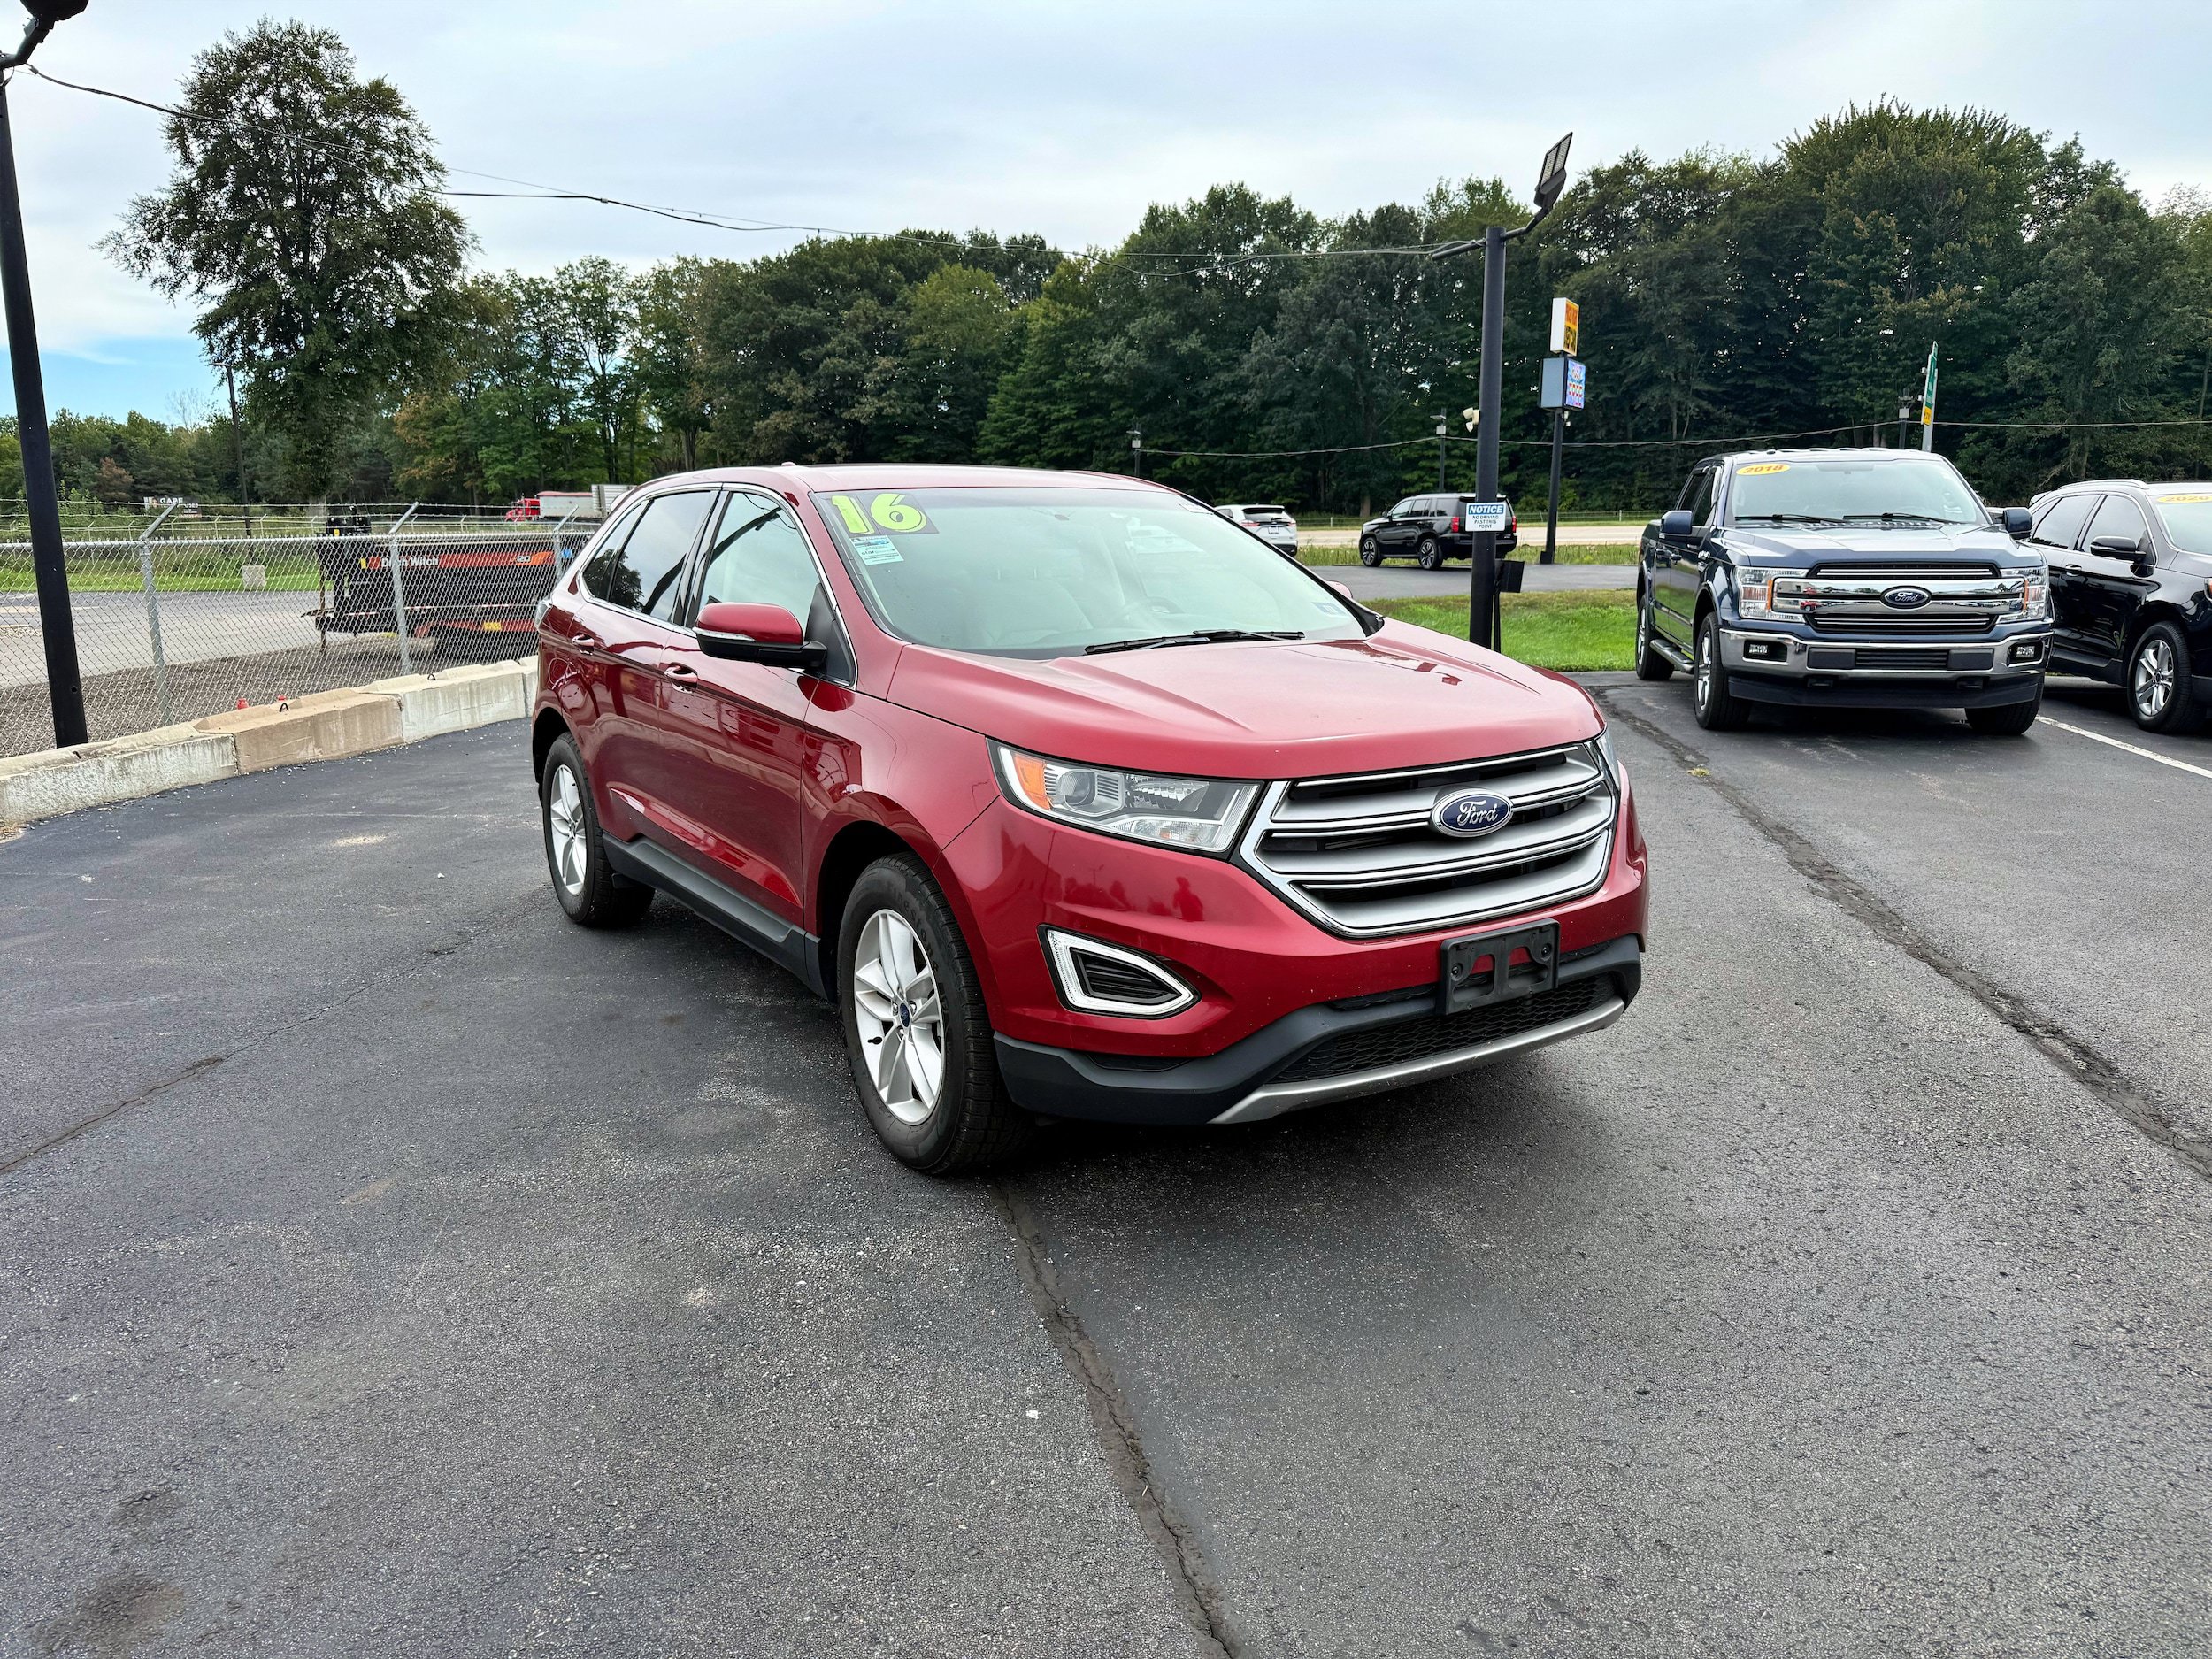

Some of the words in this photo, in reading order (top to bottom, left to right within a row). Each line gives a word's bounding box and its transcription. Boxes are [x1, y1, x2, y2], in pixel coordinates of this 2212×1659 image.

[1743, 465, 1784, 473] 2018
[831, 493, 927, 534] 16
[1469, 505, 1503, 514] NOTICE
[381, 557, 408, 567] Dich
[410, 557, 438, 567] Witch
[1894, 591, 1919, 602] Ford
[1456, 798, 1500, 827] Ford
